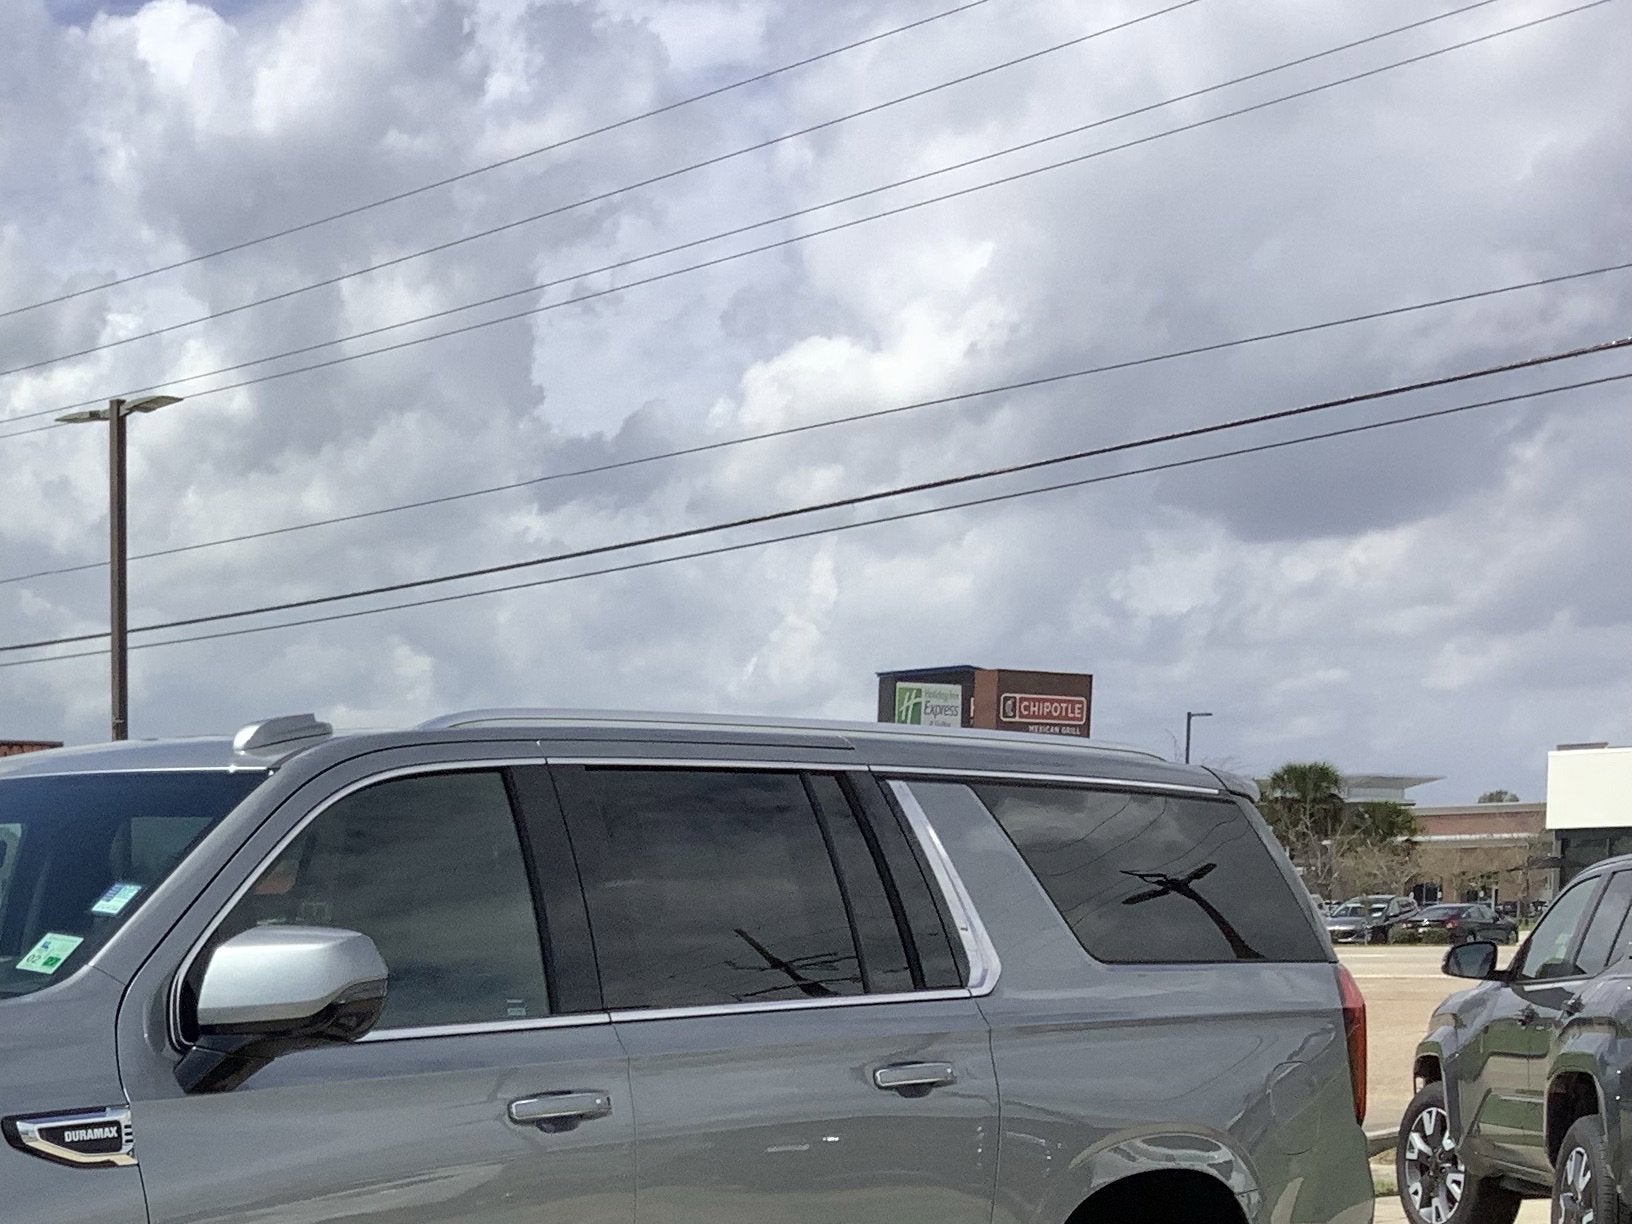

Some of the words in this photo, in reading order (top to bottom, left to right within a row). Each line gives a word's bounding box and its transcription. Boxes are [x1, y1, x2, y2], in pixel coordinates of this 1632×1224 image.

[923, 700, 960, 719] Express
[1020, 701, 1083, 718] CHIPOTLE
[1028, 725, 1060, 735] MEXICAN
[1061, 726, 1081, 736] GRILL
[64, 1126, 118, 1142] DURAMAX
